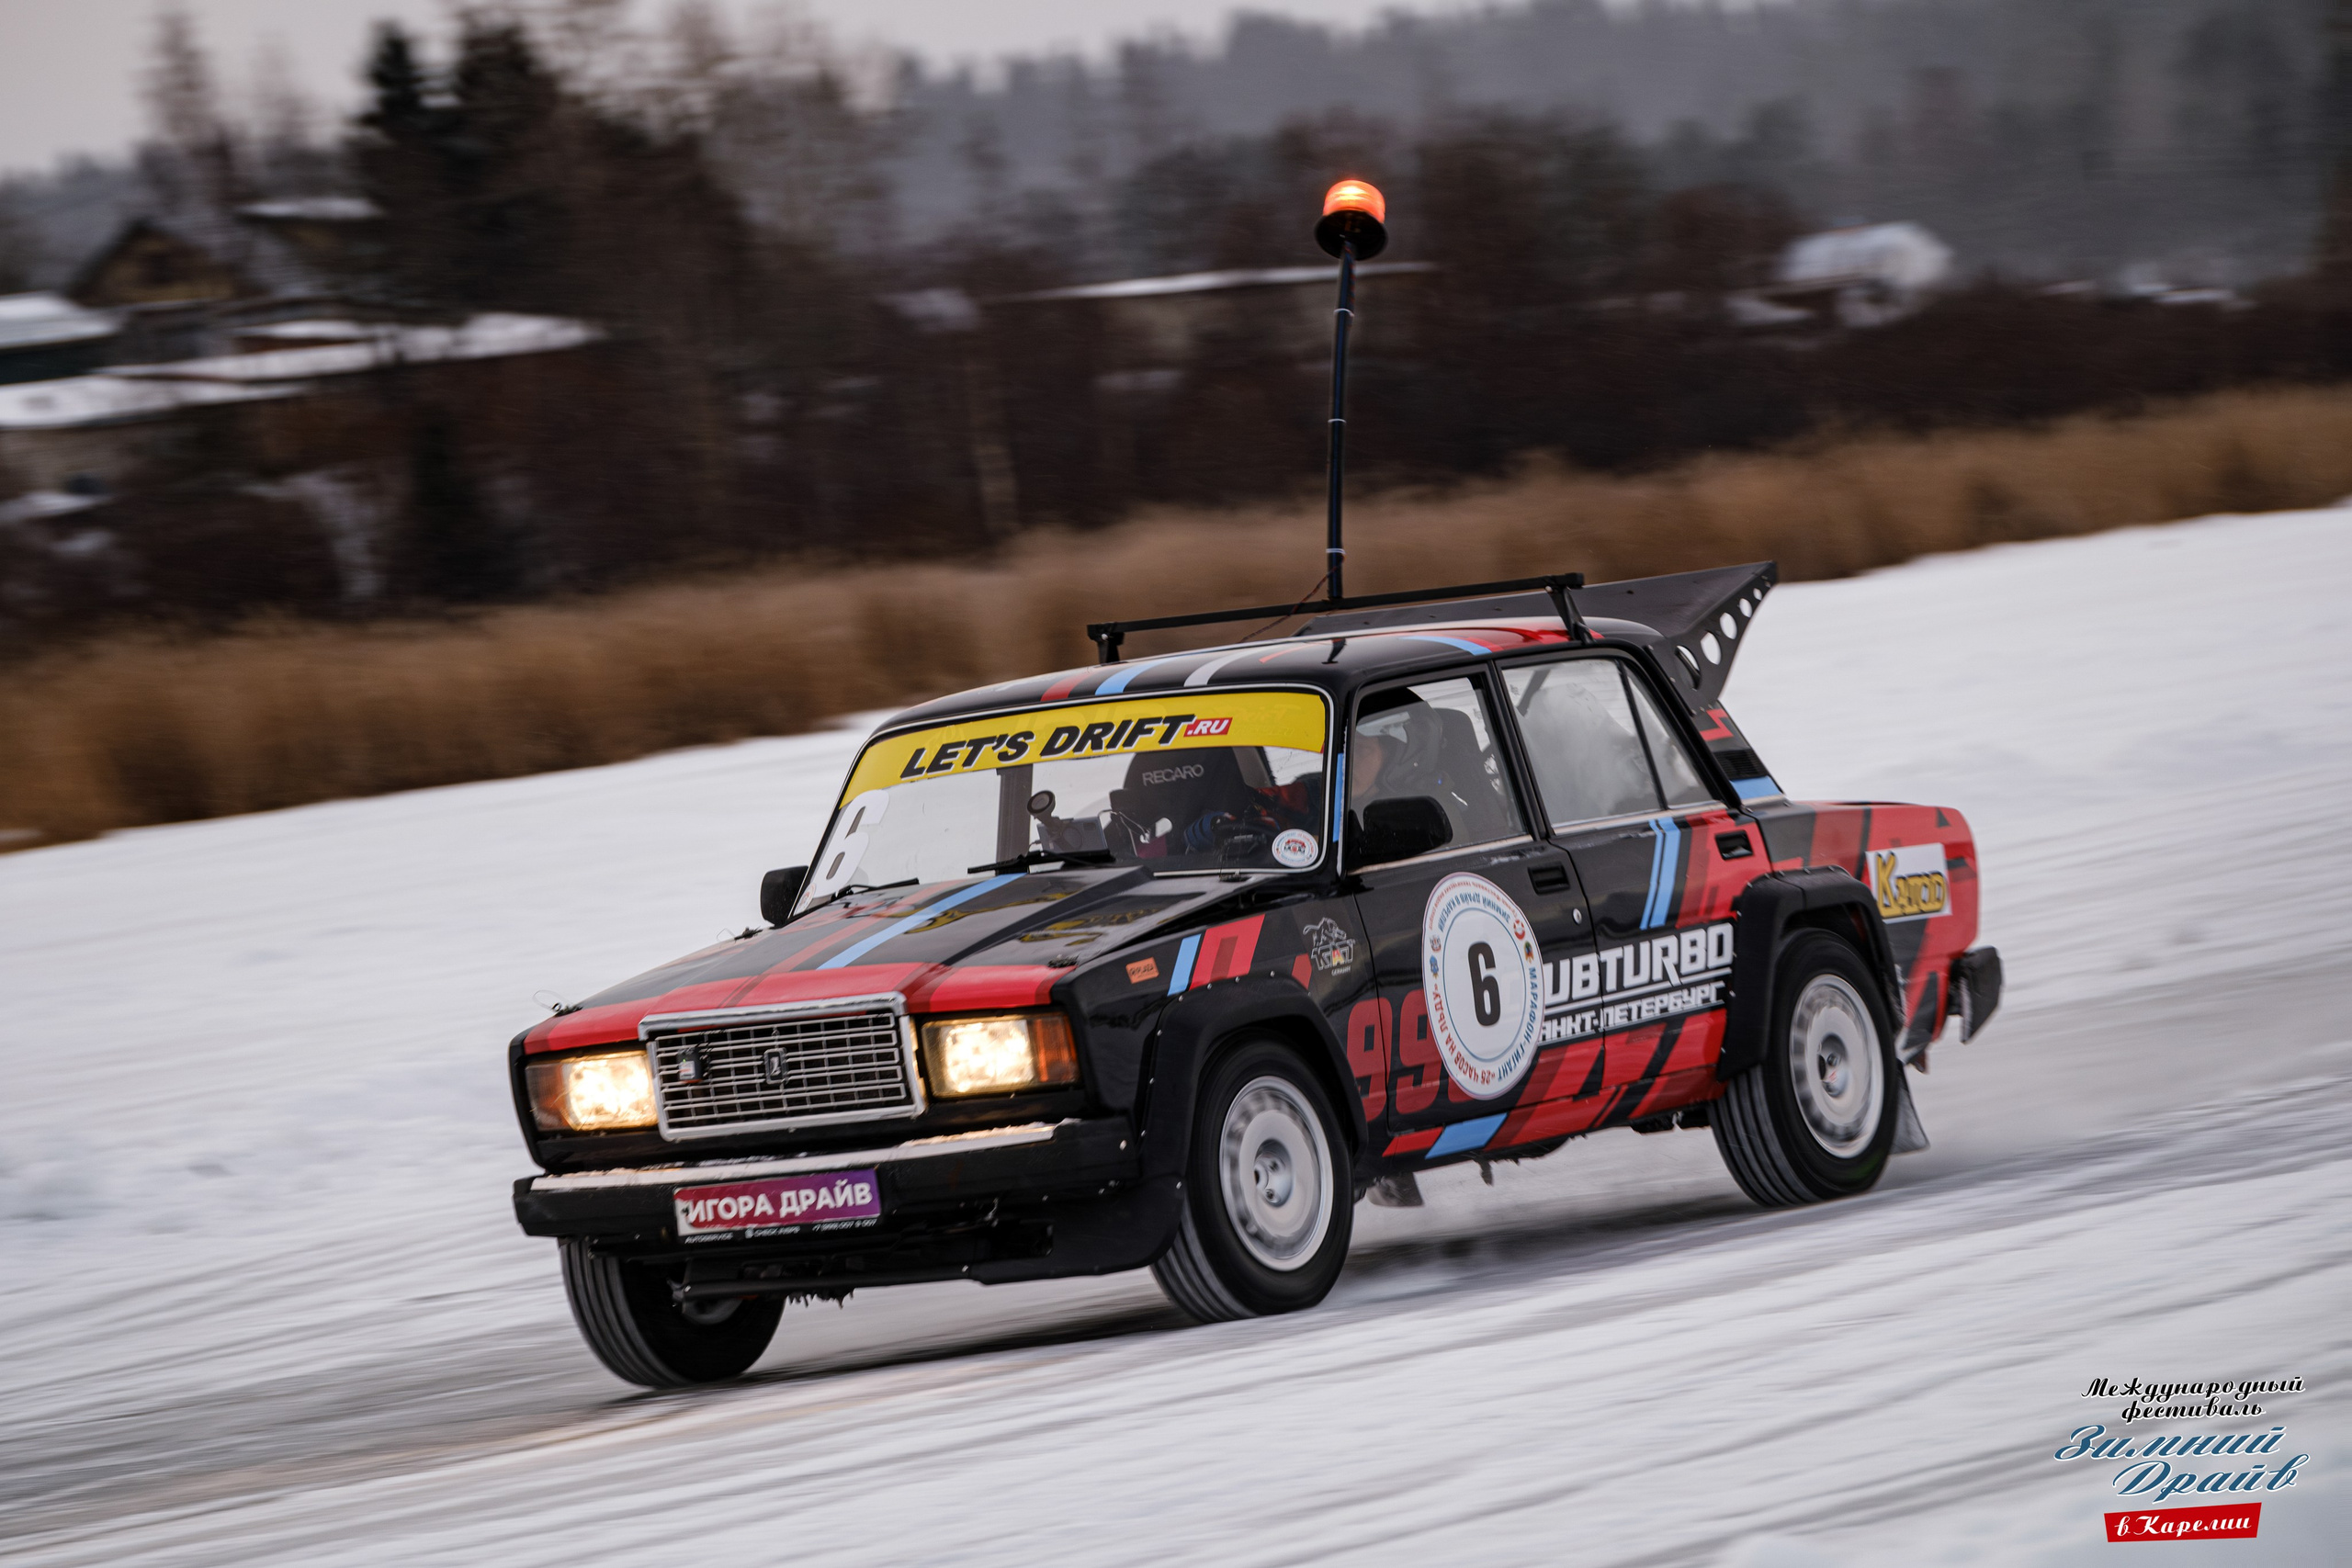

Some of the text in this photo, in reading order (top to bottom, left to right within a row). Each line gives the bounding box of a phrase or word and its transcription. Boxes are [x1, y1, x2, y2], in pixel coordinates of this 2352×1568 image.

[900, 730, 1035, 780] LET'S
[1142, 763, 1204, 786] RECARO
[811, 789, 889, 897] 6
[1436, 897, 1456, 932] КАРЕЛИИ
[1458, 891, 1480, 904] ДРАЙВ
[1481, 895, 1510, 923] ЗИМНИЙ
[1467, 940, 1500, 1027] 6
[1543, 922, 1734, 1006] UBTURBO
[1540, 981, 1724, 1042] АНКТ-ПЕТЕРБУРГ
[1443, 1032, 1456, 1055] НА
[1453, 1049, 1479, 1083] ЧАСОВ
[688, 1179, 872, 1224] ИГОРА ДРАЙВ
